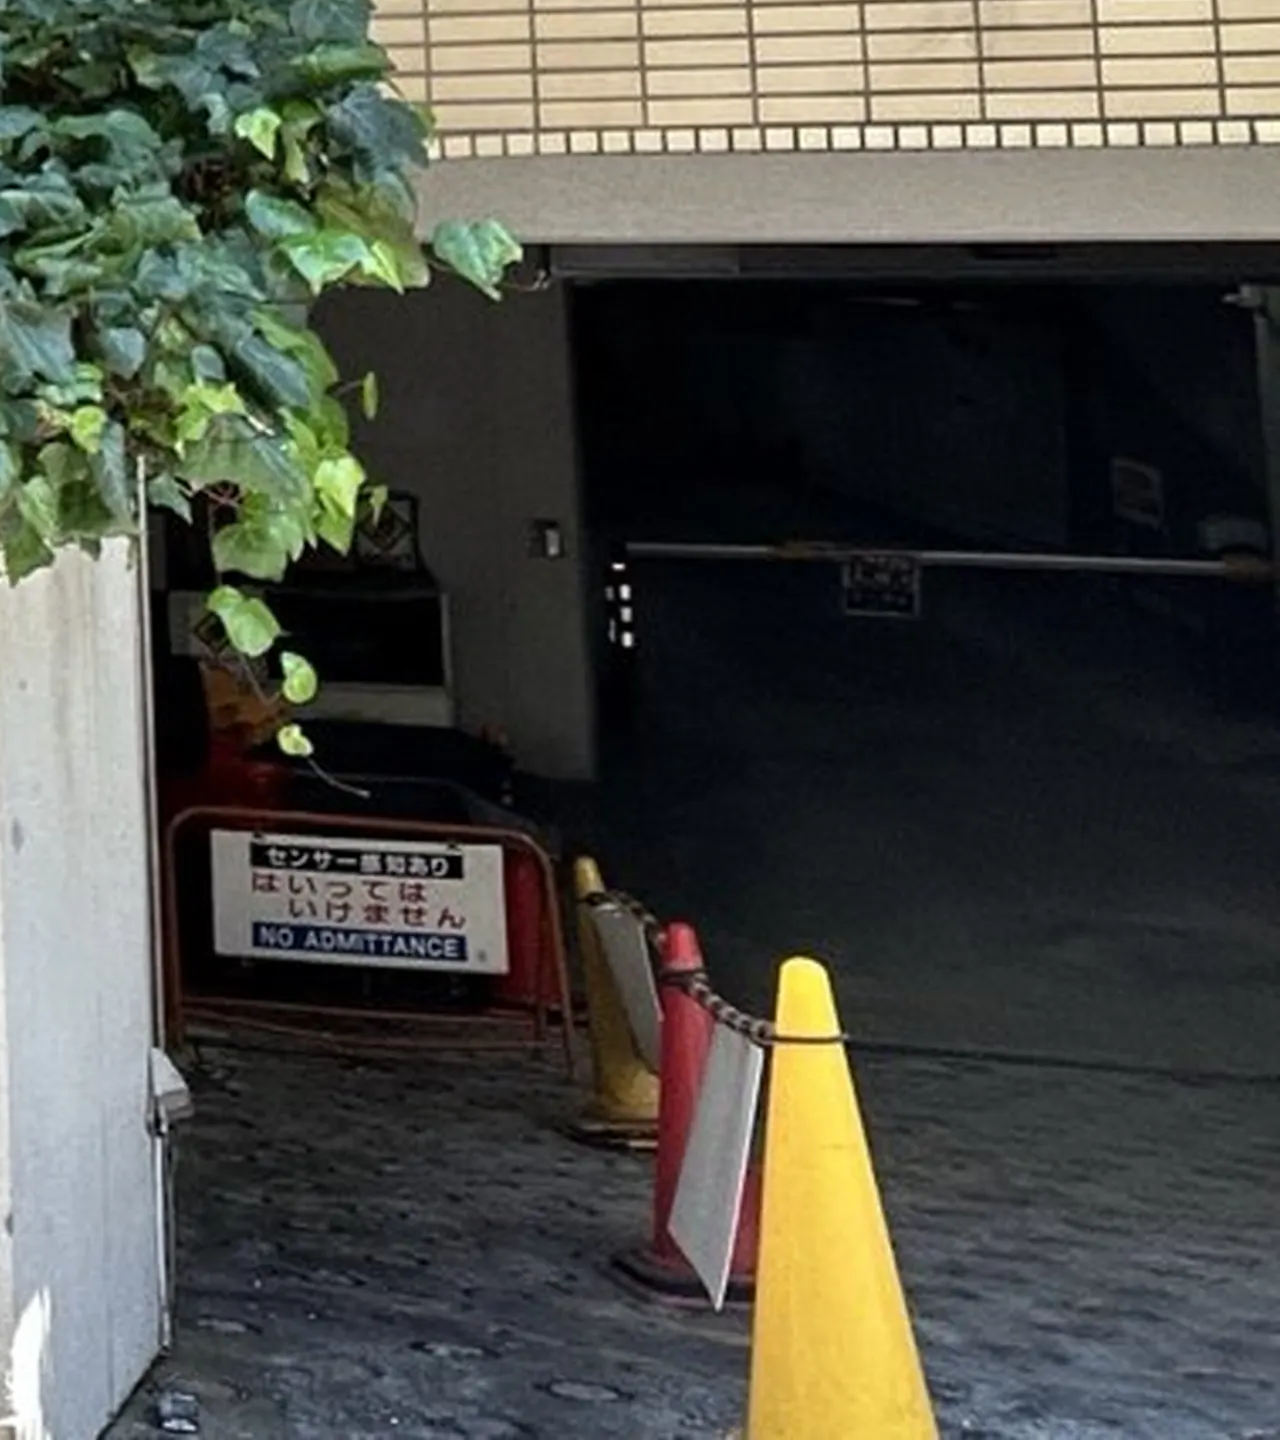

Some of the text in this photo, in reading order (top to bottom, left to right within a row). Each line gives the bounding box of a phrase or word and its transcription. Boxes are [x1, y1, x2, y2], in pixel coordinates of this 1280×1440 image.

[265, 846, 450, 877] センサー感知あり
[252, 872, 428, 903] はいっては
[288, 899, 466, 929] いけません
[260, 924, 461, 957] NO ADMITTANCE
